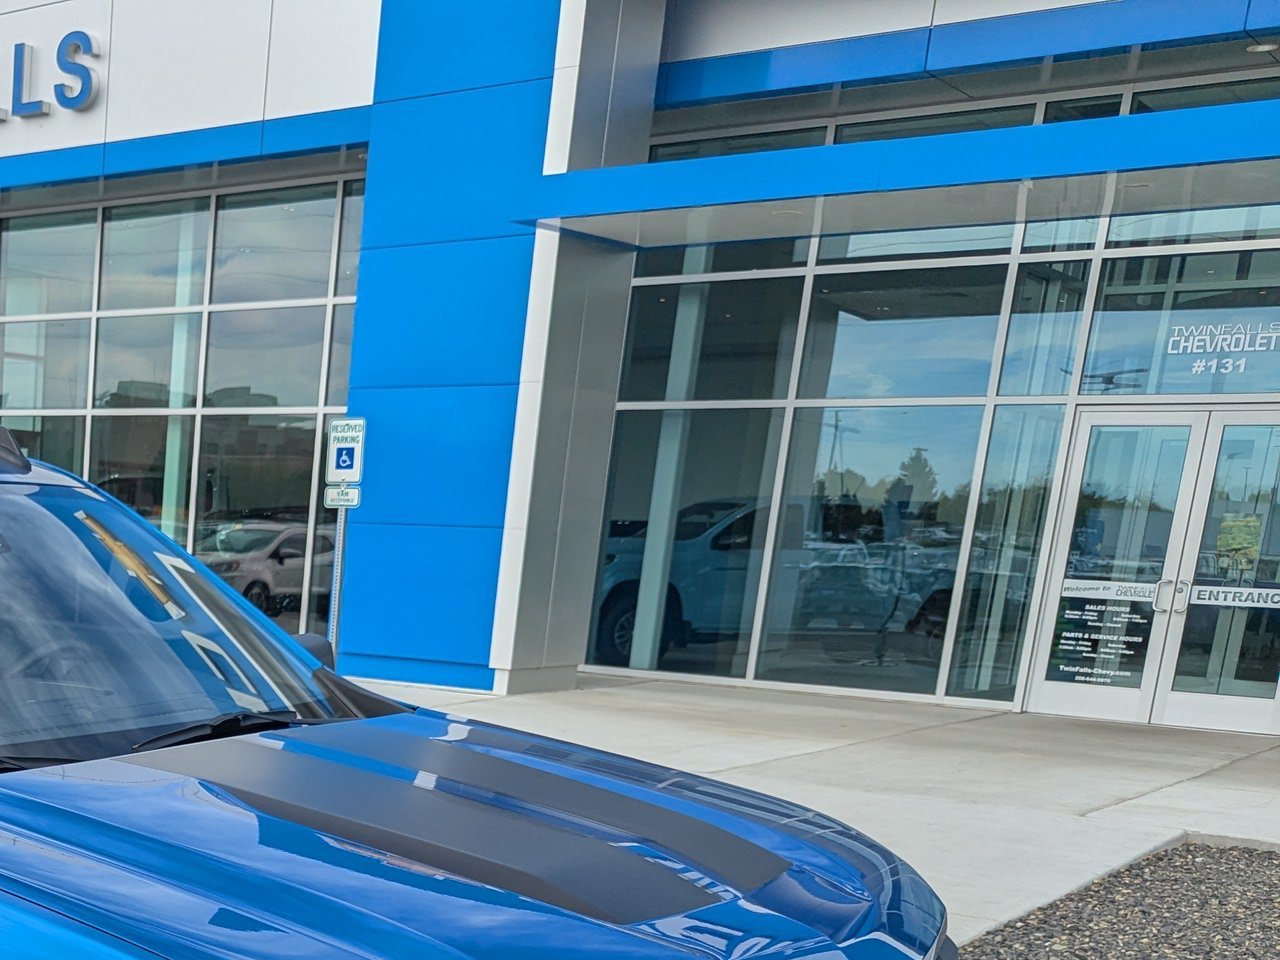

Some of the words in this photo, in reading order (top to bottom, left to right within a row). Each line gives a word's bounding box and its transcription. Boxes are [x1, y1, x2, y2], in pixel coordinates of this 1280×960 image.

[1171, 321, 1280, 337] TWINFALLS
[1167, 332, 1280, 354] CHEVROLET
[1191, 357, 1247, 375] #131
[332, 424, 362, 433] RESERVED
[332, 435, 360, 445] PARKING
[336, 490, 349, 498] VAN
[1090, 633, 1118, 641] SERVICE
[1060, 665, 1130, 676] TwinFalls-Chevy.com
